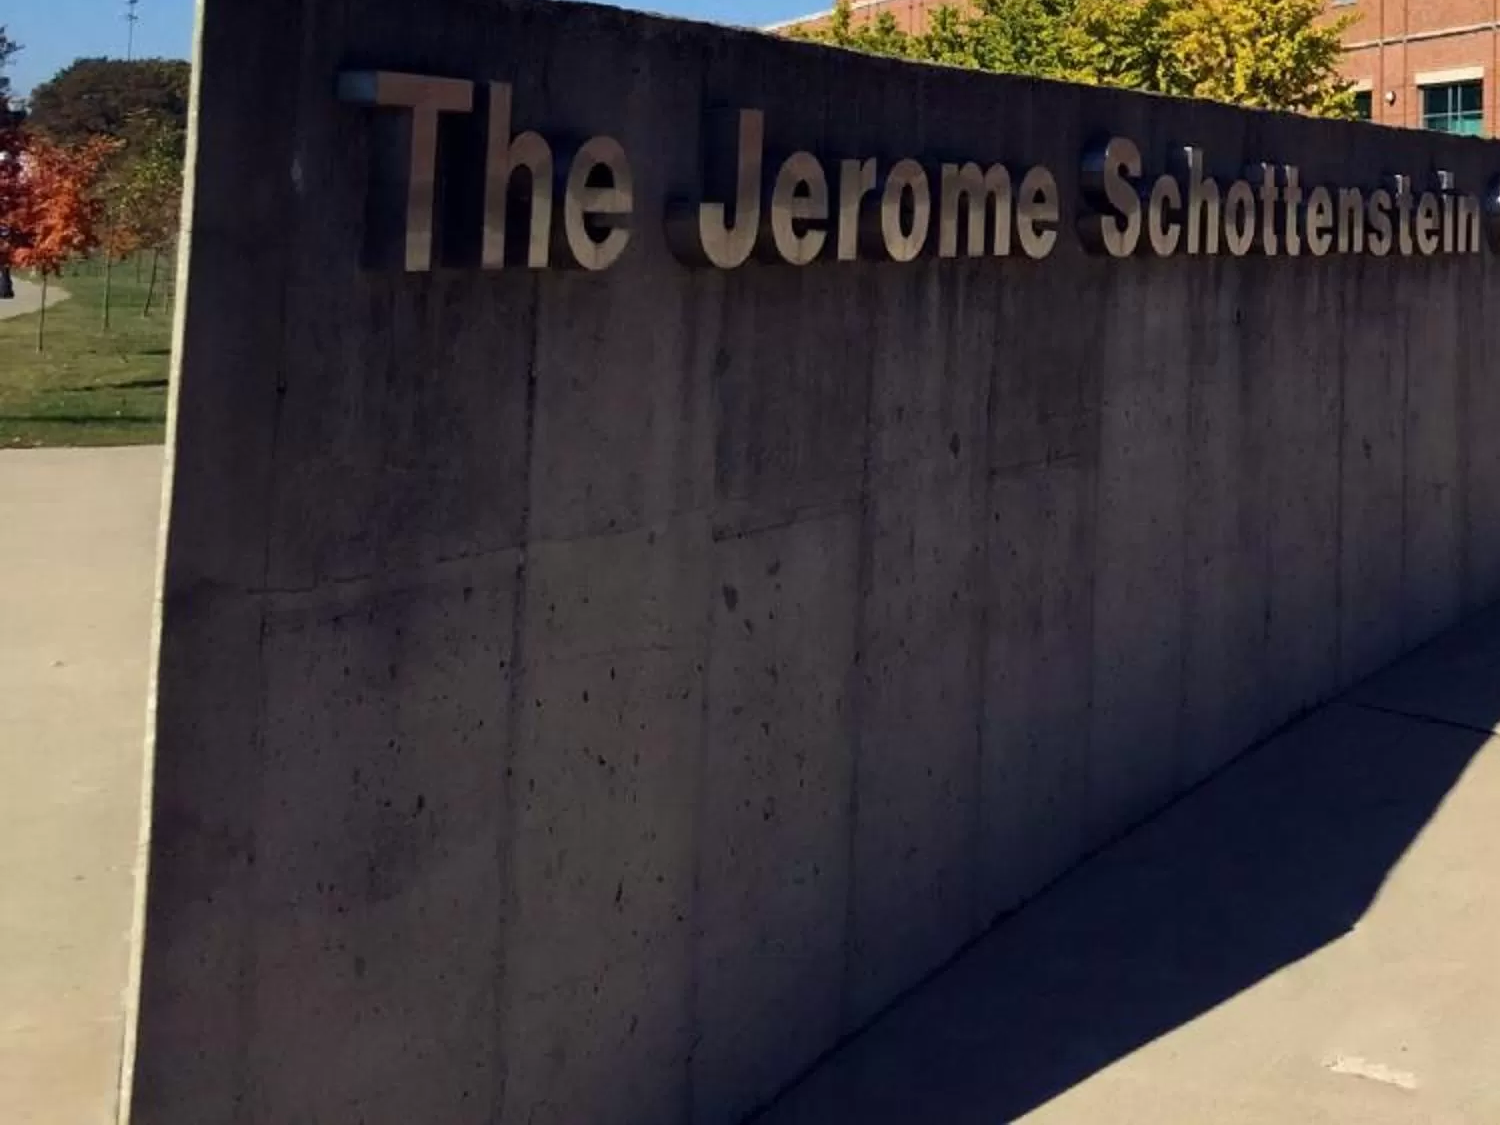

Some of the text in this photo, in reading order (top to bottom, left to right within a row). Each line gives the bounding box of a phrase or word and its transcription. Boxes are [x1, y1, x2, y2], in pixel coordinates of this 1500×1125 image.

[372, 70, 634, 273] The
[698, 108, 1060, 269] Jerome
[1100, 136, 1481, 258] Schottenstein
